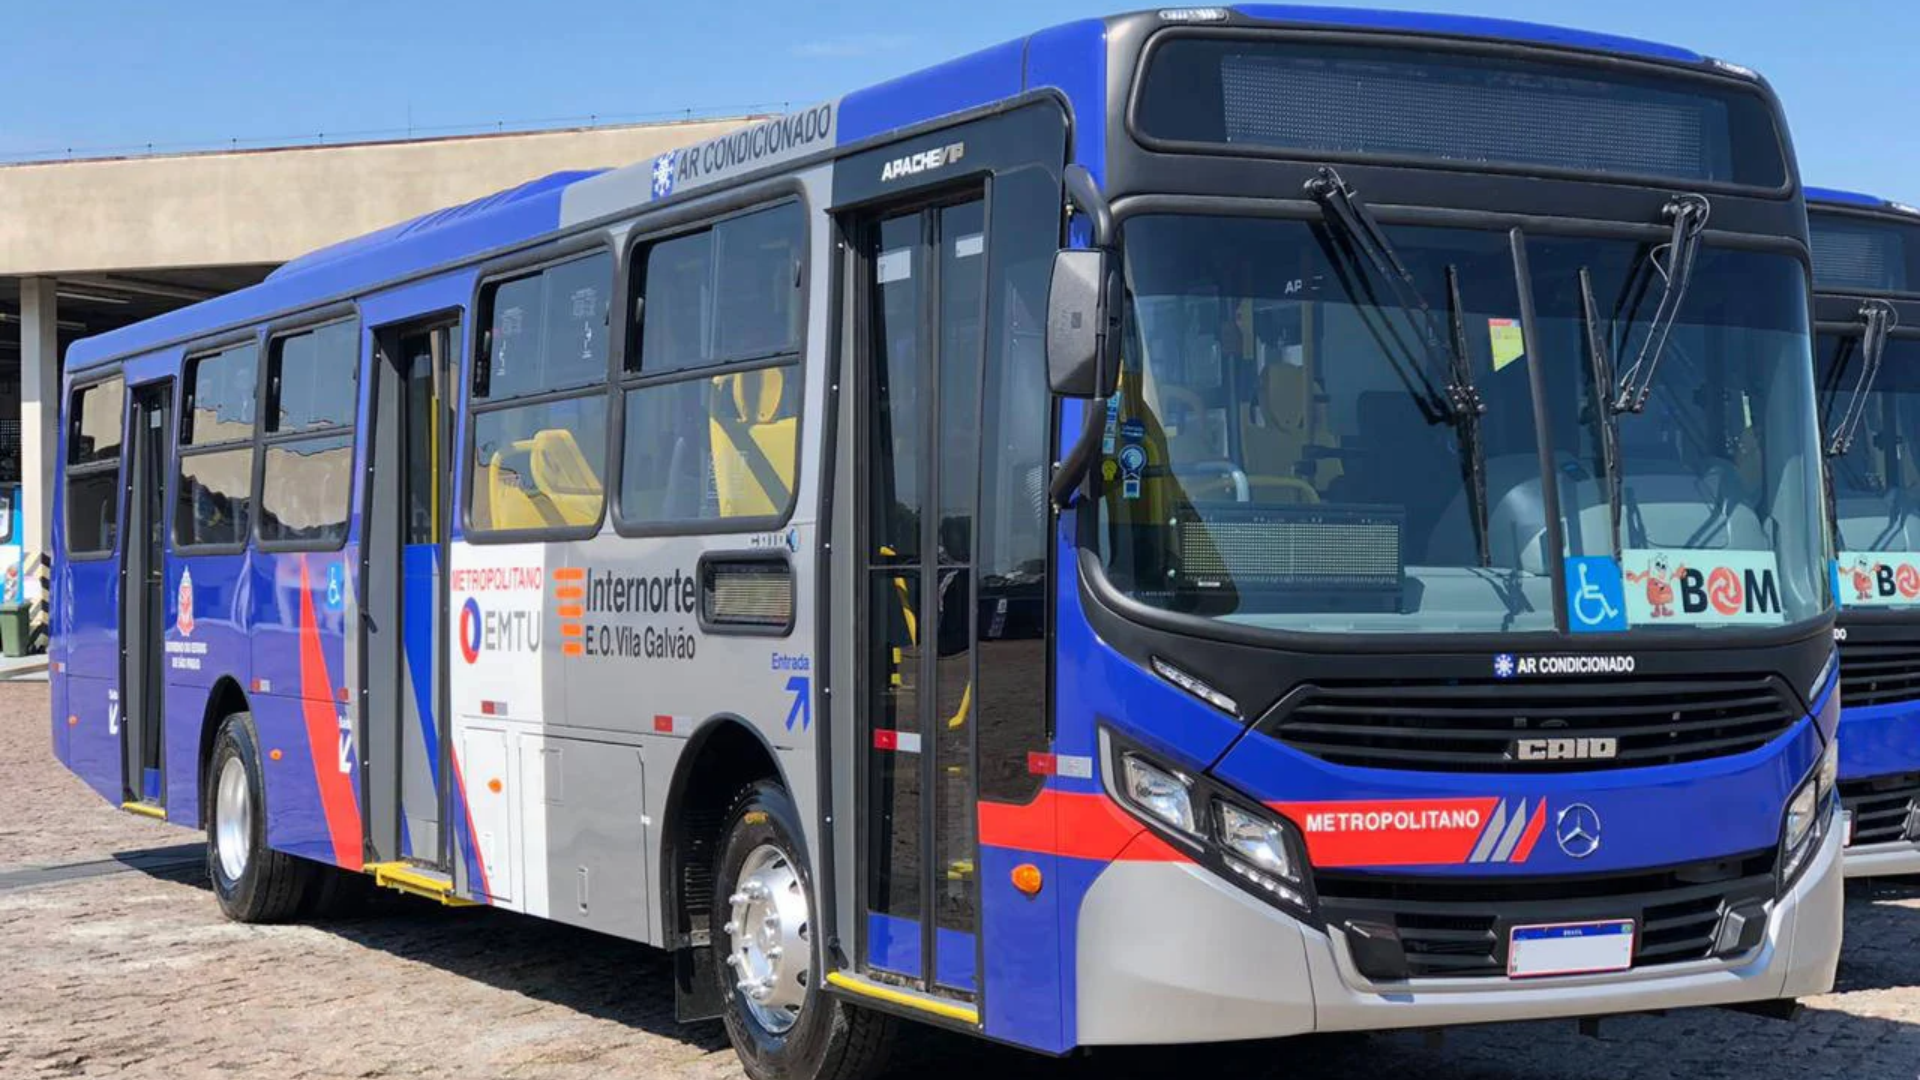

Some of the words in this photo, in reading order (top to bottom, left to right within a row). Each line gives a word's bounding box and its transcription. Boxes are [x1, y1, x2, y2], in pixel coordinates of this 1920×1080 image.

[677, 147, 700, 181] AR
[703, 103, 832, 174] CONDICIONADO
[452, 567, 541, 592] METROPOLITANO
[586, 567, 696, 614] Internorte
[1680, 566, 1781, 616] BOM
[485, 610, 540, 652] EMTU
[586, 625, 598, 655] E.
[600, 625, 614, 656] O.
[616, 626, 641, 658] Vila
[772, 652, 809, 670] Entrada
[1518, 657, 1537, 673] AR
[1539, 656, 1635, 673] CONDICIONADO
[1518, 738, 1617, 760] CAIO
[1306, 809, 1480, 832] METROPOLITANO
